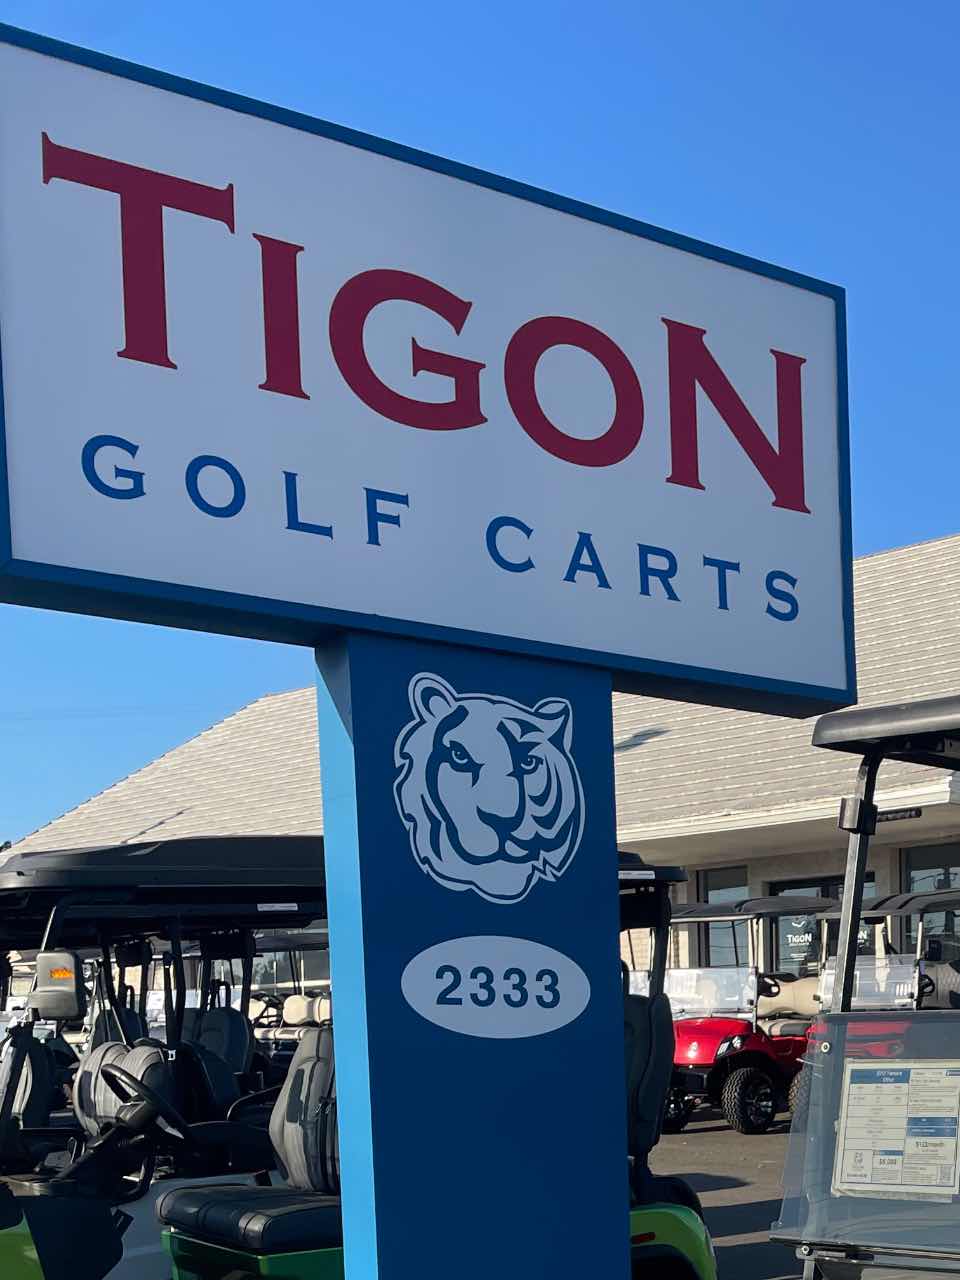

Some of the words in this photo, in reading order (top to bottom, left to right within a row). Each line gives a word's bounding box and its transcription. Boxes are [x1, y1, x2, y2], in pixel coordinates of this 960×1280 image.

[42, 131, 811, 514] TIGON
[81, 435, 409, 546] GOLF
[485, 515, 800, 622] CARTS
[435, 964, 560, 1008] 2333
